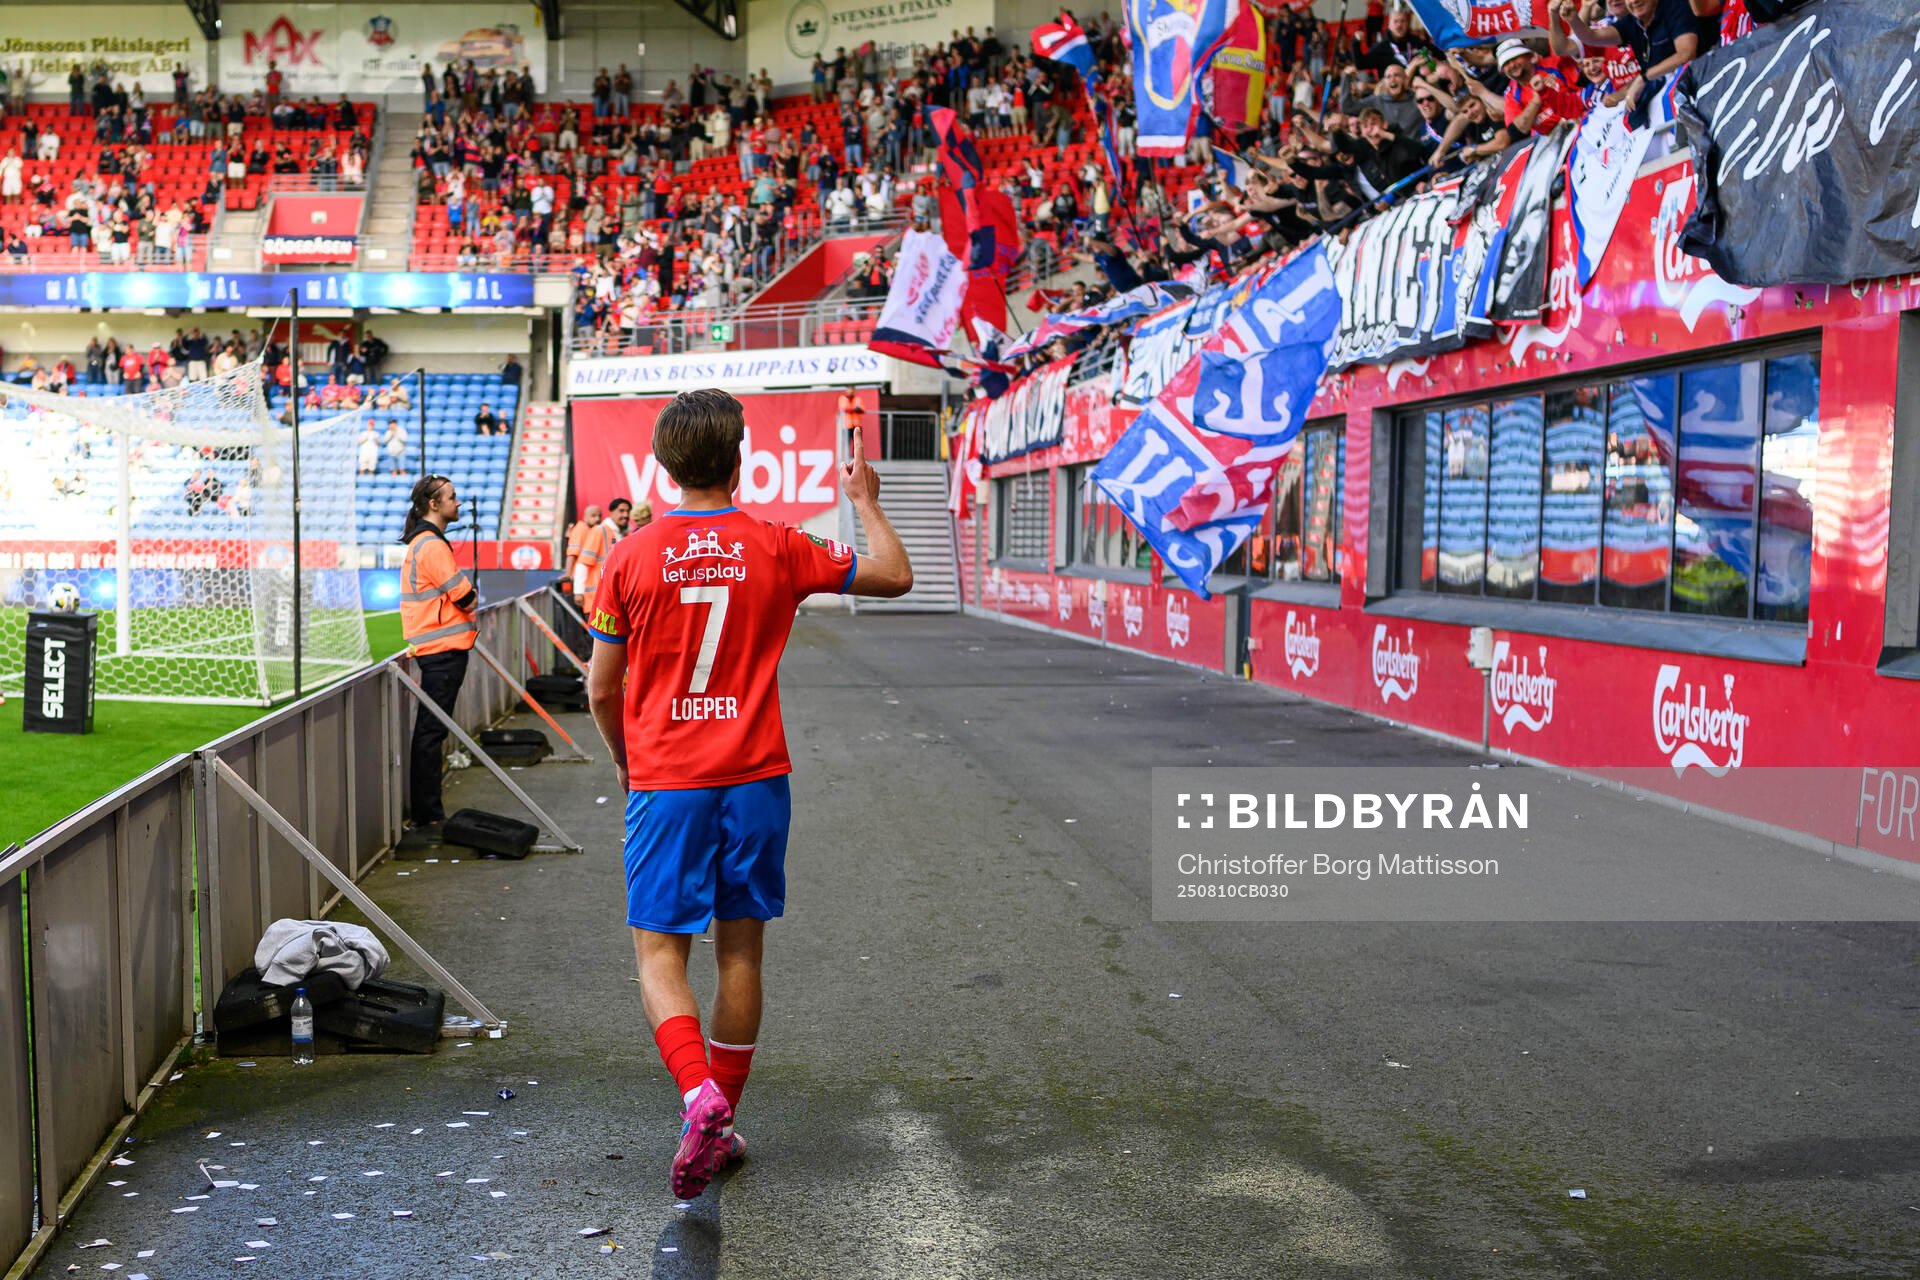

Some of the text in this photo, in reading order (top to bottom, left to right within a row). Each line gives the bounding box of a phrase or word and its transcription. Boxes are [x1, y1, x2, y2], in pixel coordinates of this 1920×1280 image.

[1, 37, 190, 55] Jönssons Plåtslageri
[145, 58, 174, 73] AB
[242, 15, 325, 66] MAX
[574, 354, 880, 385] KLIPPANS BUSS KLIPPANS BUSS
[662, 563, 747, 583] letusplay
[590, 607, 618, 635] XXL
[680, 585, 729, 694] 7
[1284, 611, 1321, 678] Carlsberg
[42, 637, 66, 719] SELECT
[1372, 624, 1420, 702] Carlsberg
[1490, 641, 1557, 733] Carlsberg
[671, 697, 738, 721] LOEPER
[1653, 664, 1749, 778] Carlsberg
[1856, 767, 1919, 842] FOR
